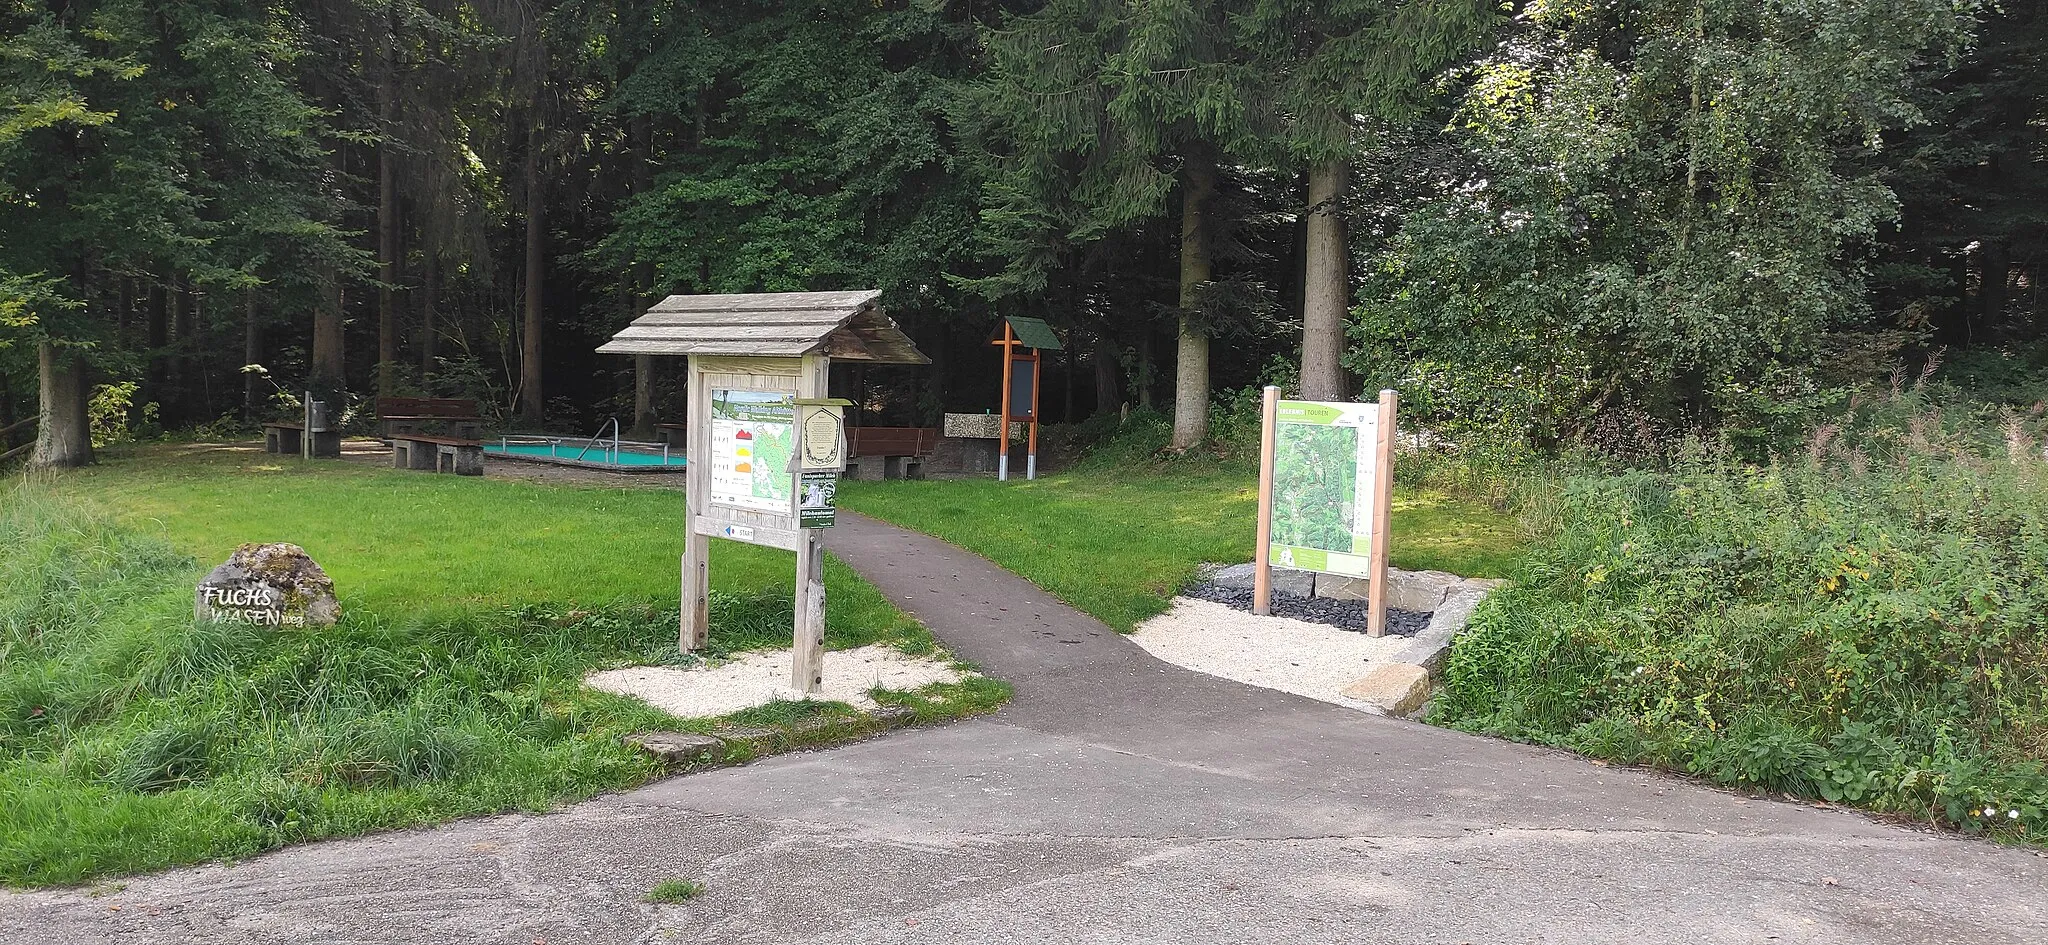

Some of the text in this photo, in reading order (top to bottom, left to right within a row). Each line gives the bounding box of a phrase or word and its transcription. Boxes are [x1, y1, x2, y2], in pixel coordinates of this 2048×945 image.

[739, 529, 753, 537] START
[203, 586, 271, 606] FUCHS
[211, 608, 305, 628] WASEN weg
